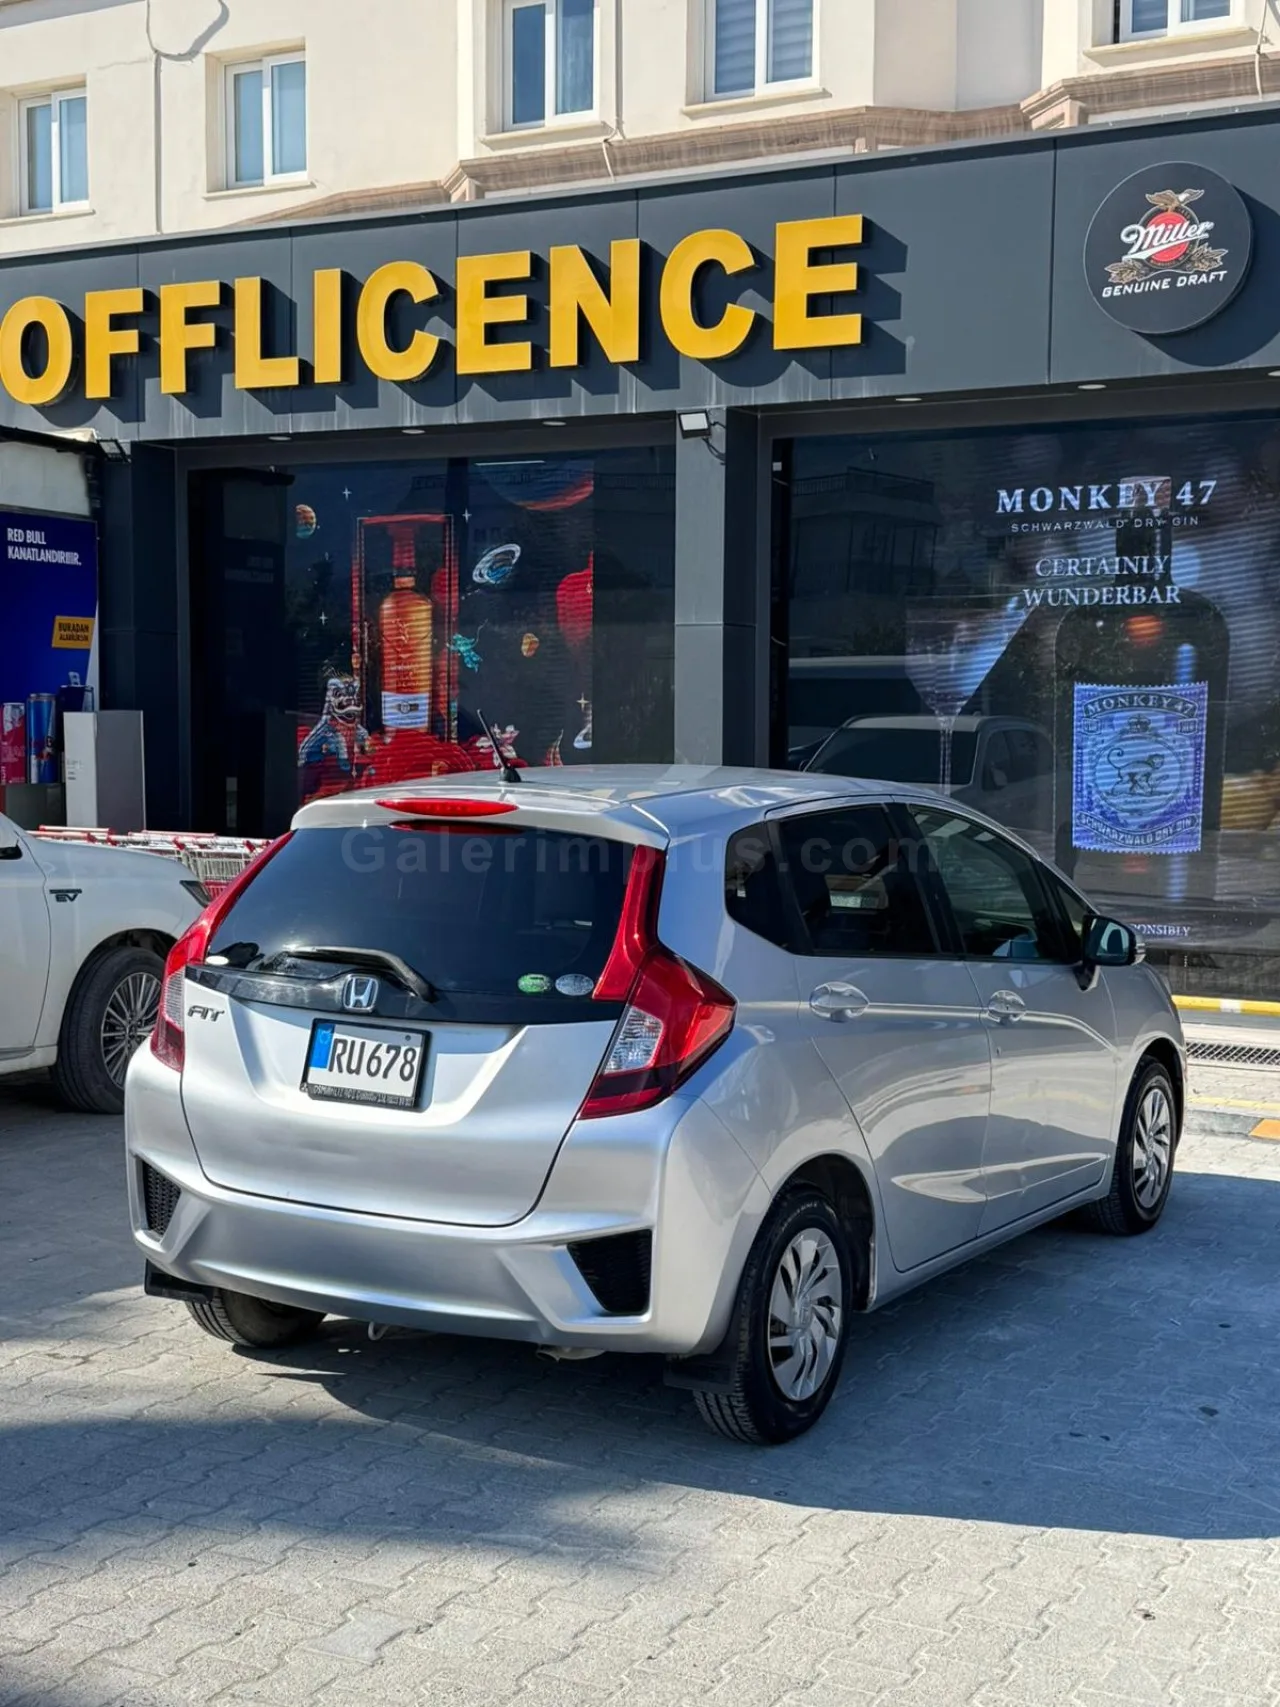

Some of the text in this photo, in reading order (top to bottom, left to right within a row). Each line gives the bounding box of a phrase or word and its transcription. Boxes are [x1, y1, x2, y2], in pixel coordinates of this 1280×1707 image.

[1121, 221, 1214, 256] Miller
[1102, 270, 1228, 298] GENUINE DRAFT
[0, 214, 864, 406] OFFLICENCE
[995, 480, 1218, 514] MONKEY 47
[1010, 516, 1200, 533] SCHWARZWALD DRY GIN
[7, 527, 46, 545] RED BULL
[1035, 555, 1169, 577] CERTAINLY
[1022, 585, 1181, 607] WUNDERBAR
[1087, 694, 1194, 715] MONKEY 47
[55, 893, 79, 902] EV
[187, 1004, 225, 1022] FIT
[327, 1038, 418, 1082] RU678
